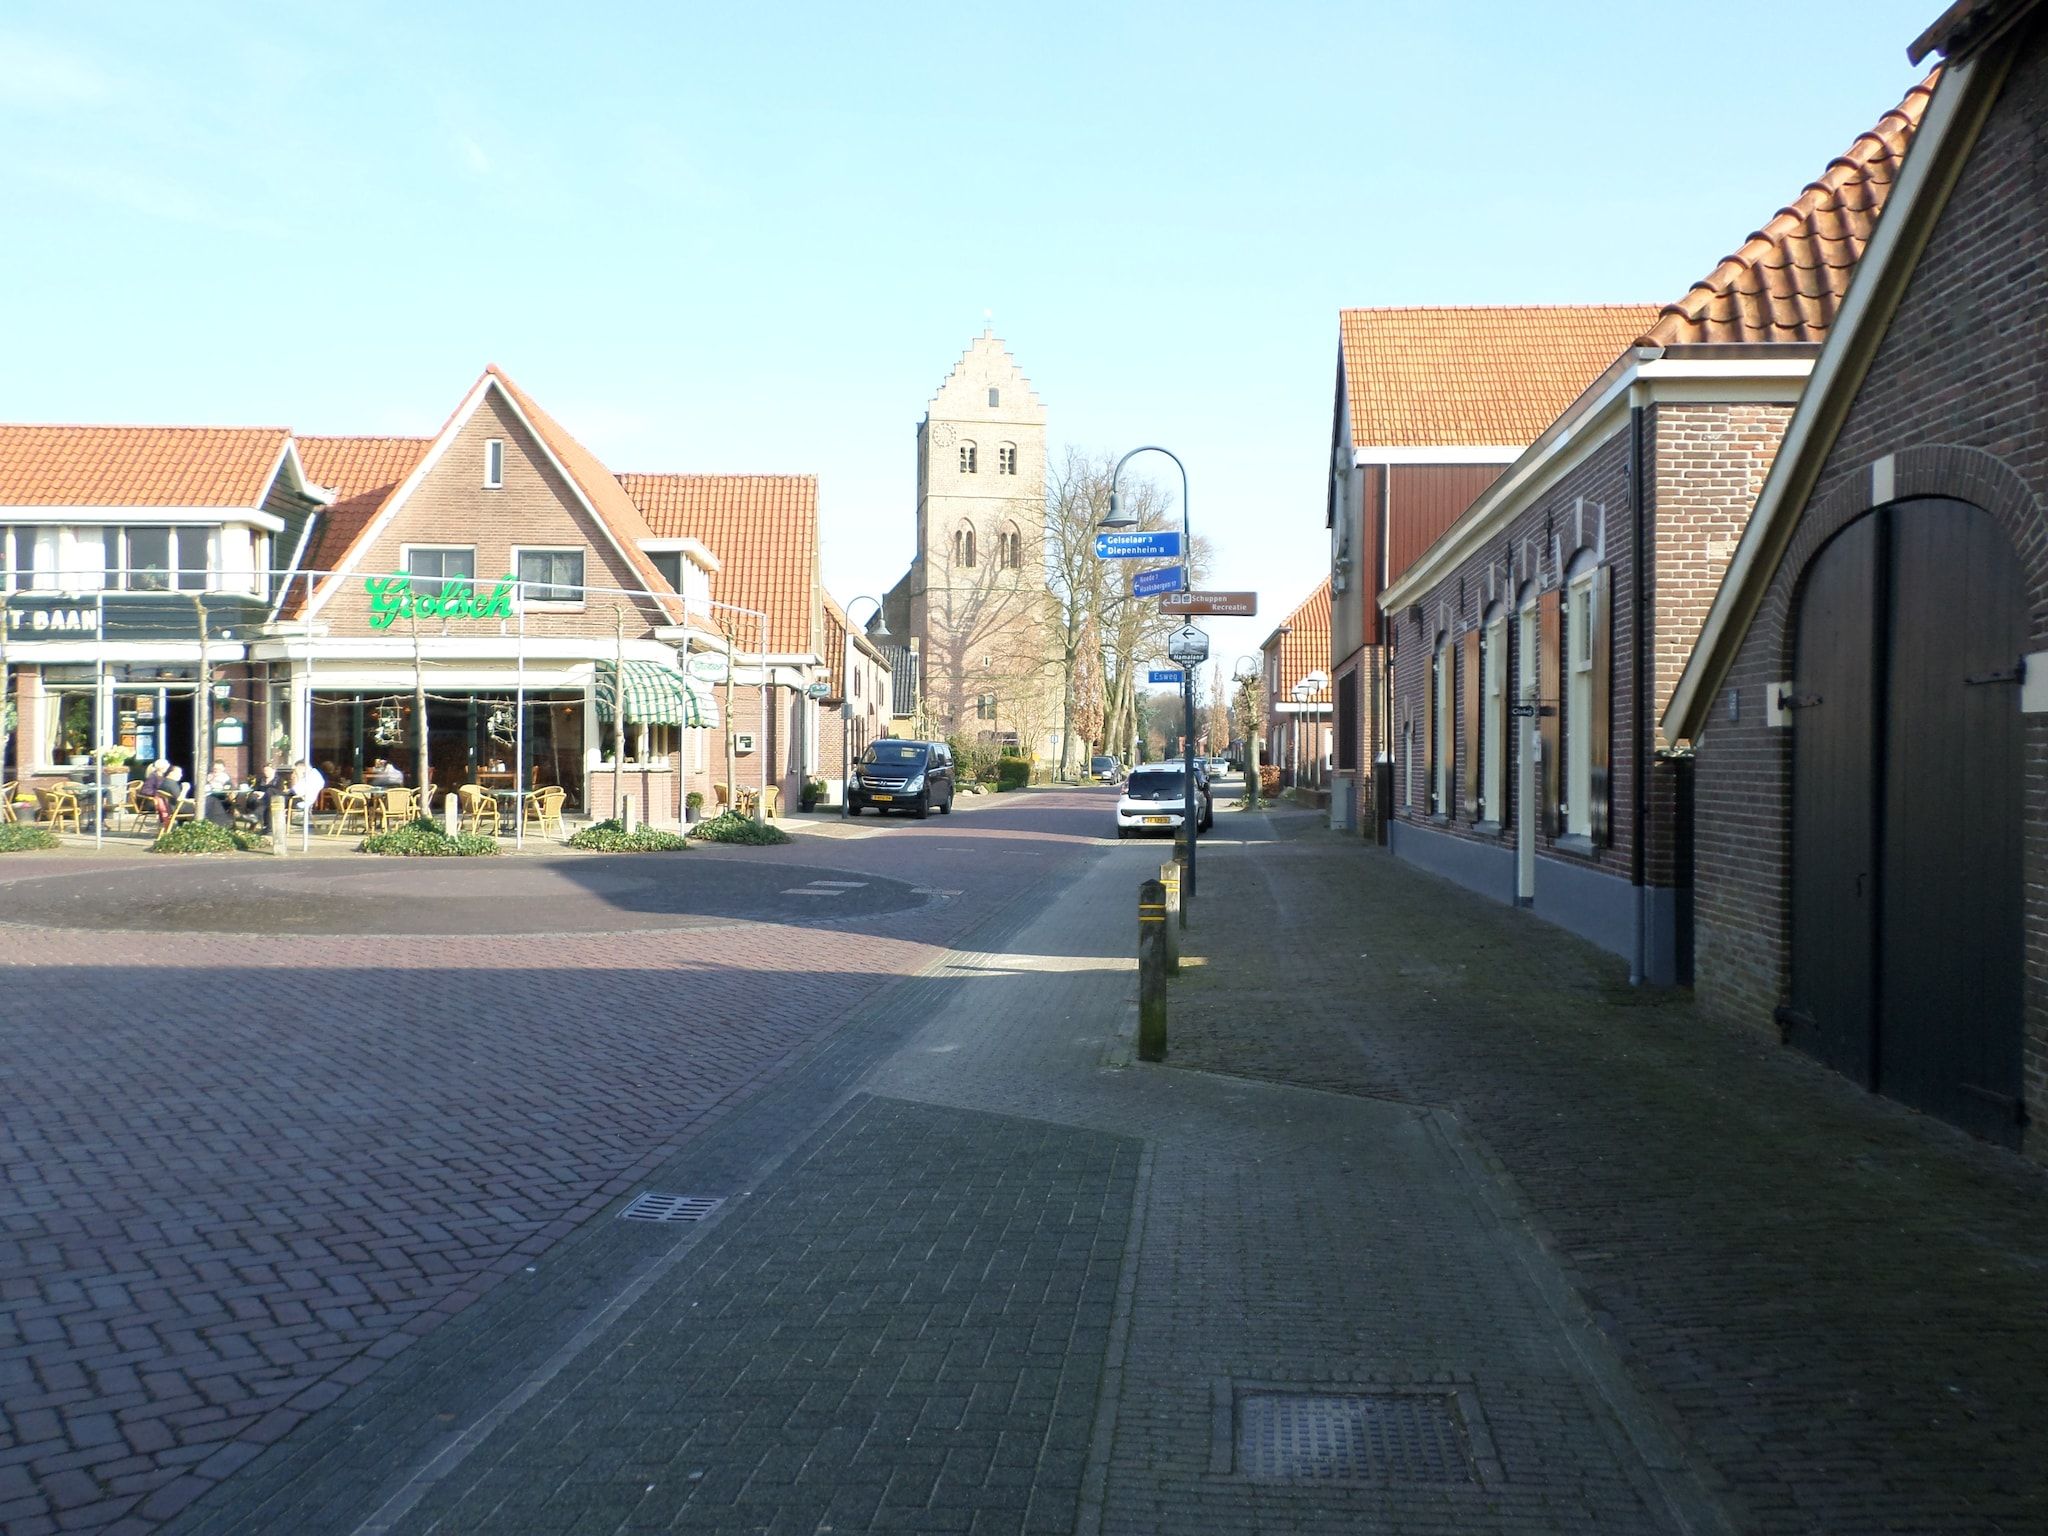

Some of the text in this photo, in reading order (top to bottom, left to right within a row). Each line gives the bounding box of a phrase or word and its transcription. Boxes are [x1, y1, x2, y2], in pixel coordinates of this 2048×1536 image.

[1107, 546, 1157, 555] Diepenheim
[364, 571, 517, 629] Grolsch
[33, 610, 97, 630] BAAN
[1153, 672, 1178, 682] Esweg
